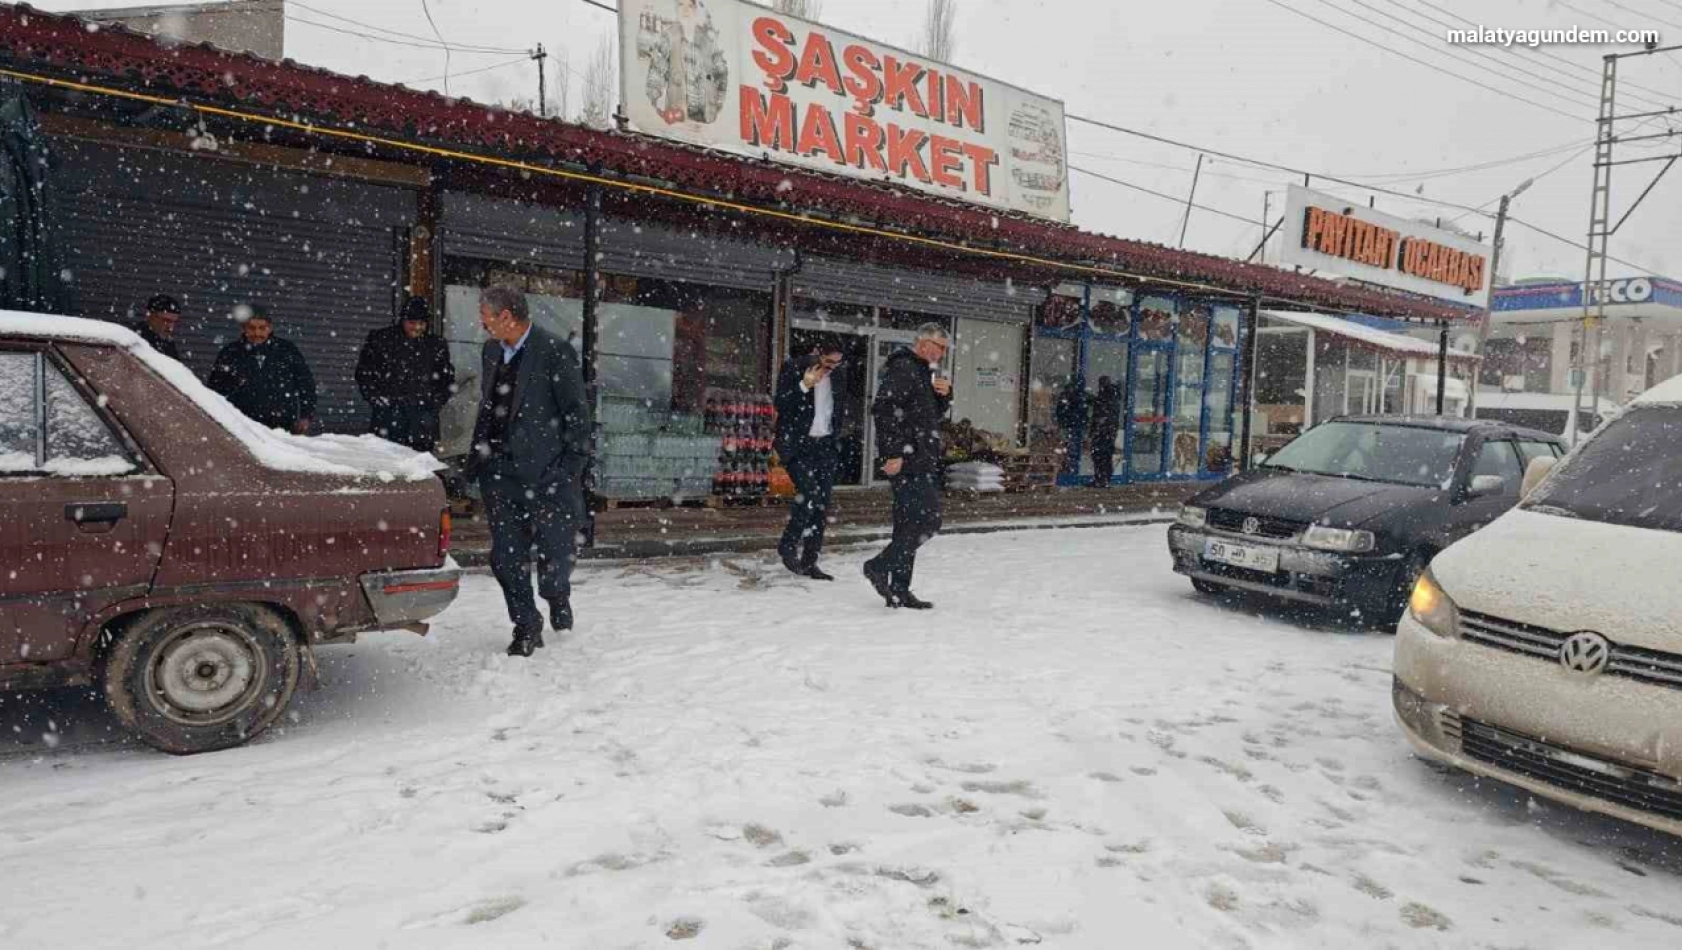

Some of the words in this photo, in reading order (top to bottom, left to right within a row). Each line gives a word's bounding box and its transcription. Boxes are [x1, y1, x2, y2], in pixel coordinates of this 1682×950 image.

[751, 16, 984, 134] ŞAŞKIN
[739, 84, 998, 197] MARKET
[1398, 236, 1486, 295] OCAKBAŞI
